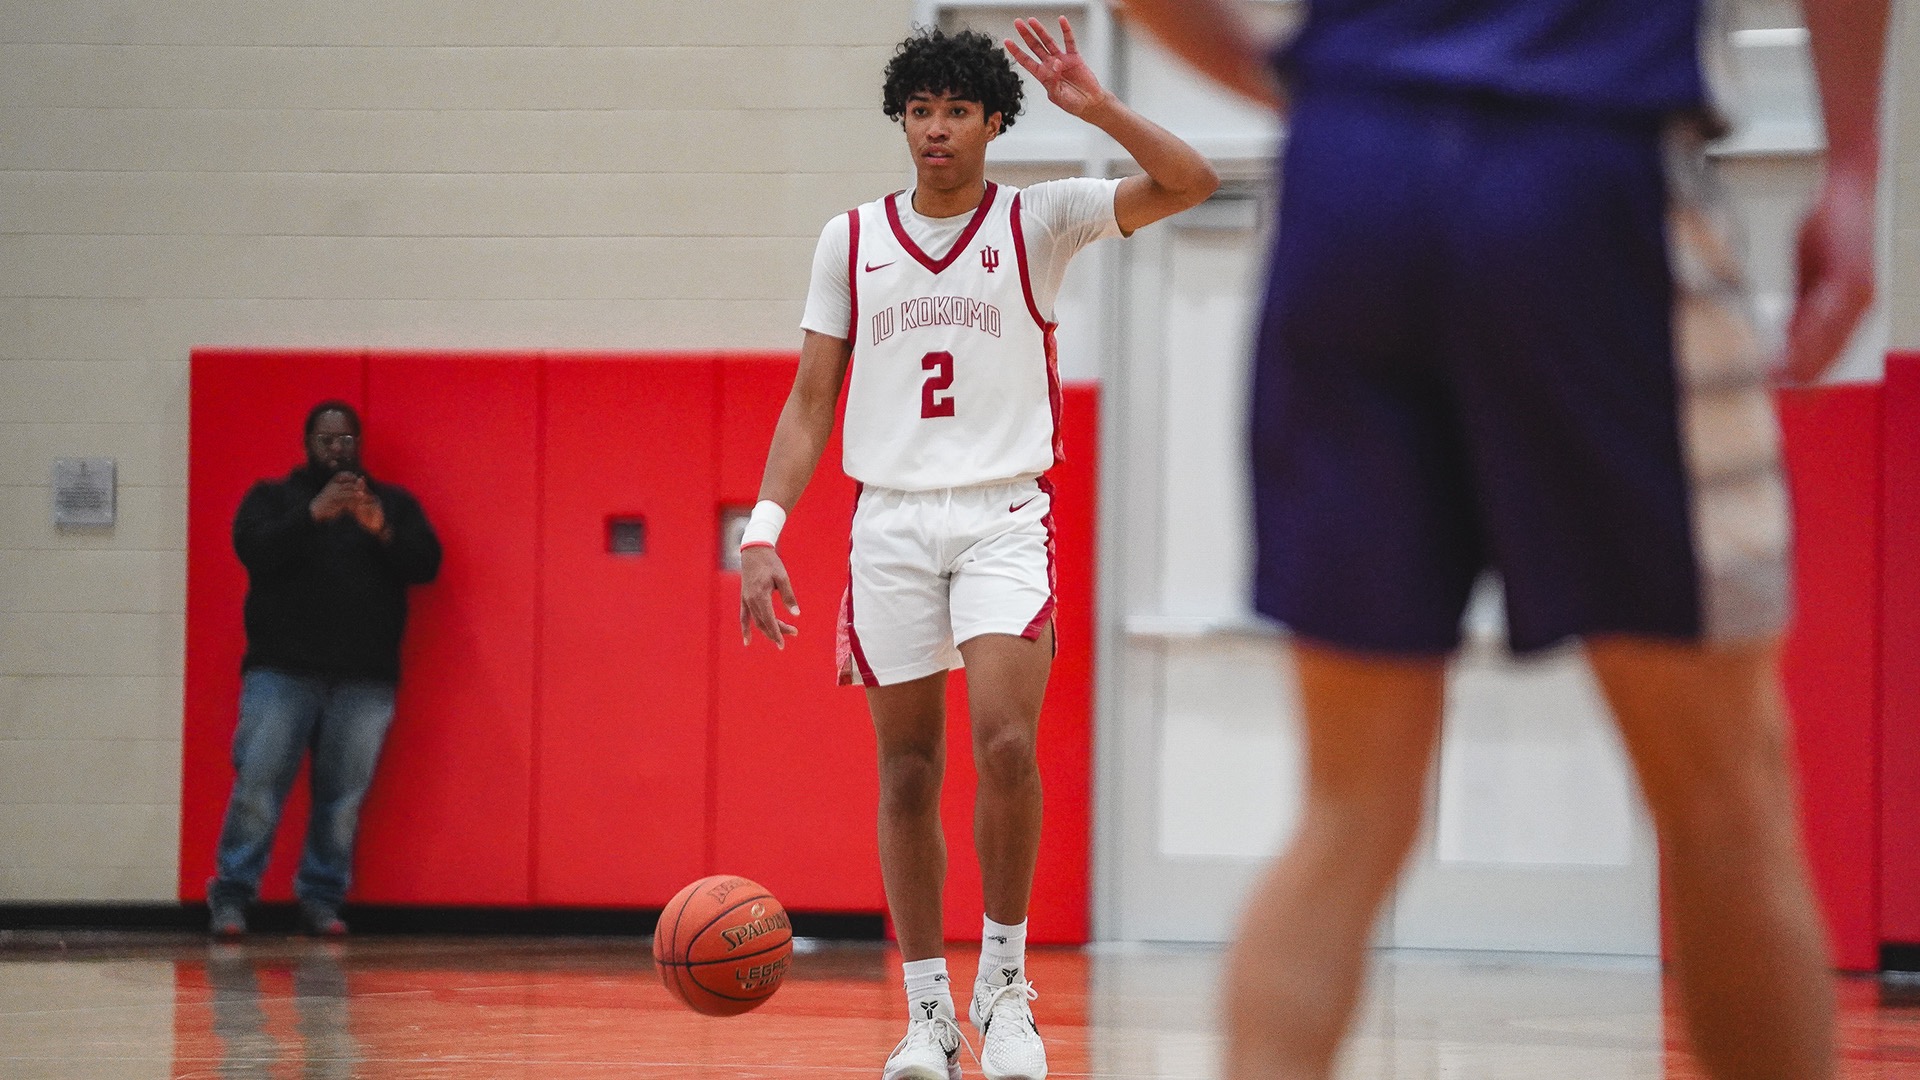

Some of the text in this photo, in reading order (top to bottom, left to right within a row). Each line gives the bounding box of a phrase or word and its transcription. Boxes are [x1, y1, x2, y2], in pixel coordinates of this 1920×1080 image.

[872, 296, 1001, 346] IU KOKOMO
[920, 350, 955, 419] 2
[721, 909, 790, 952] SPALDIN
[736, 954, 791, 980] LEGAC
